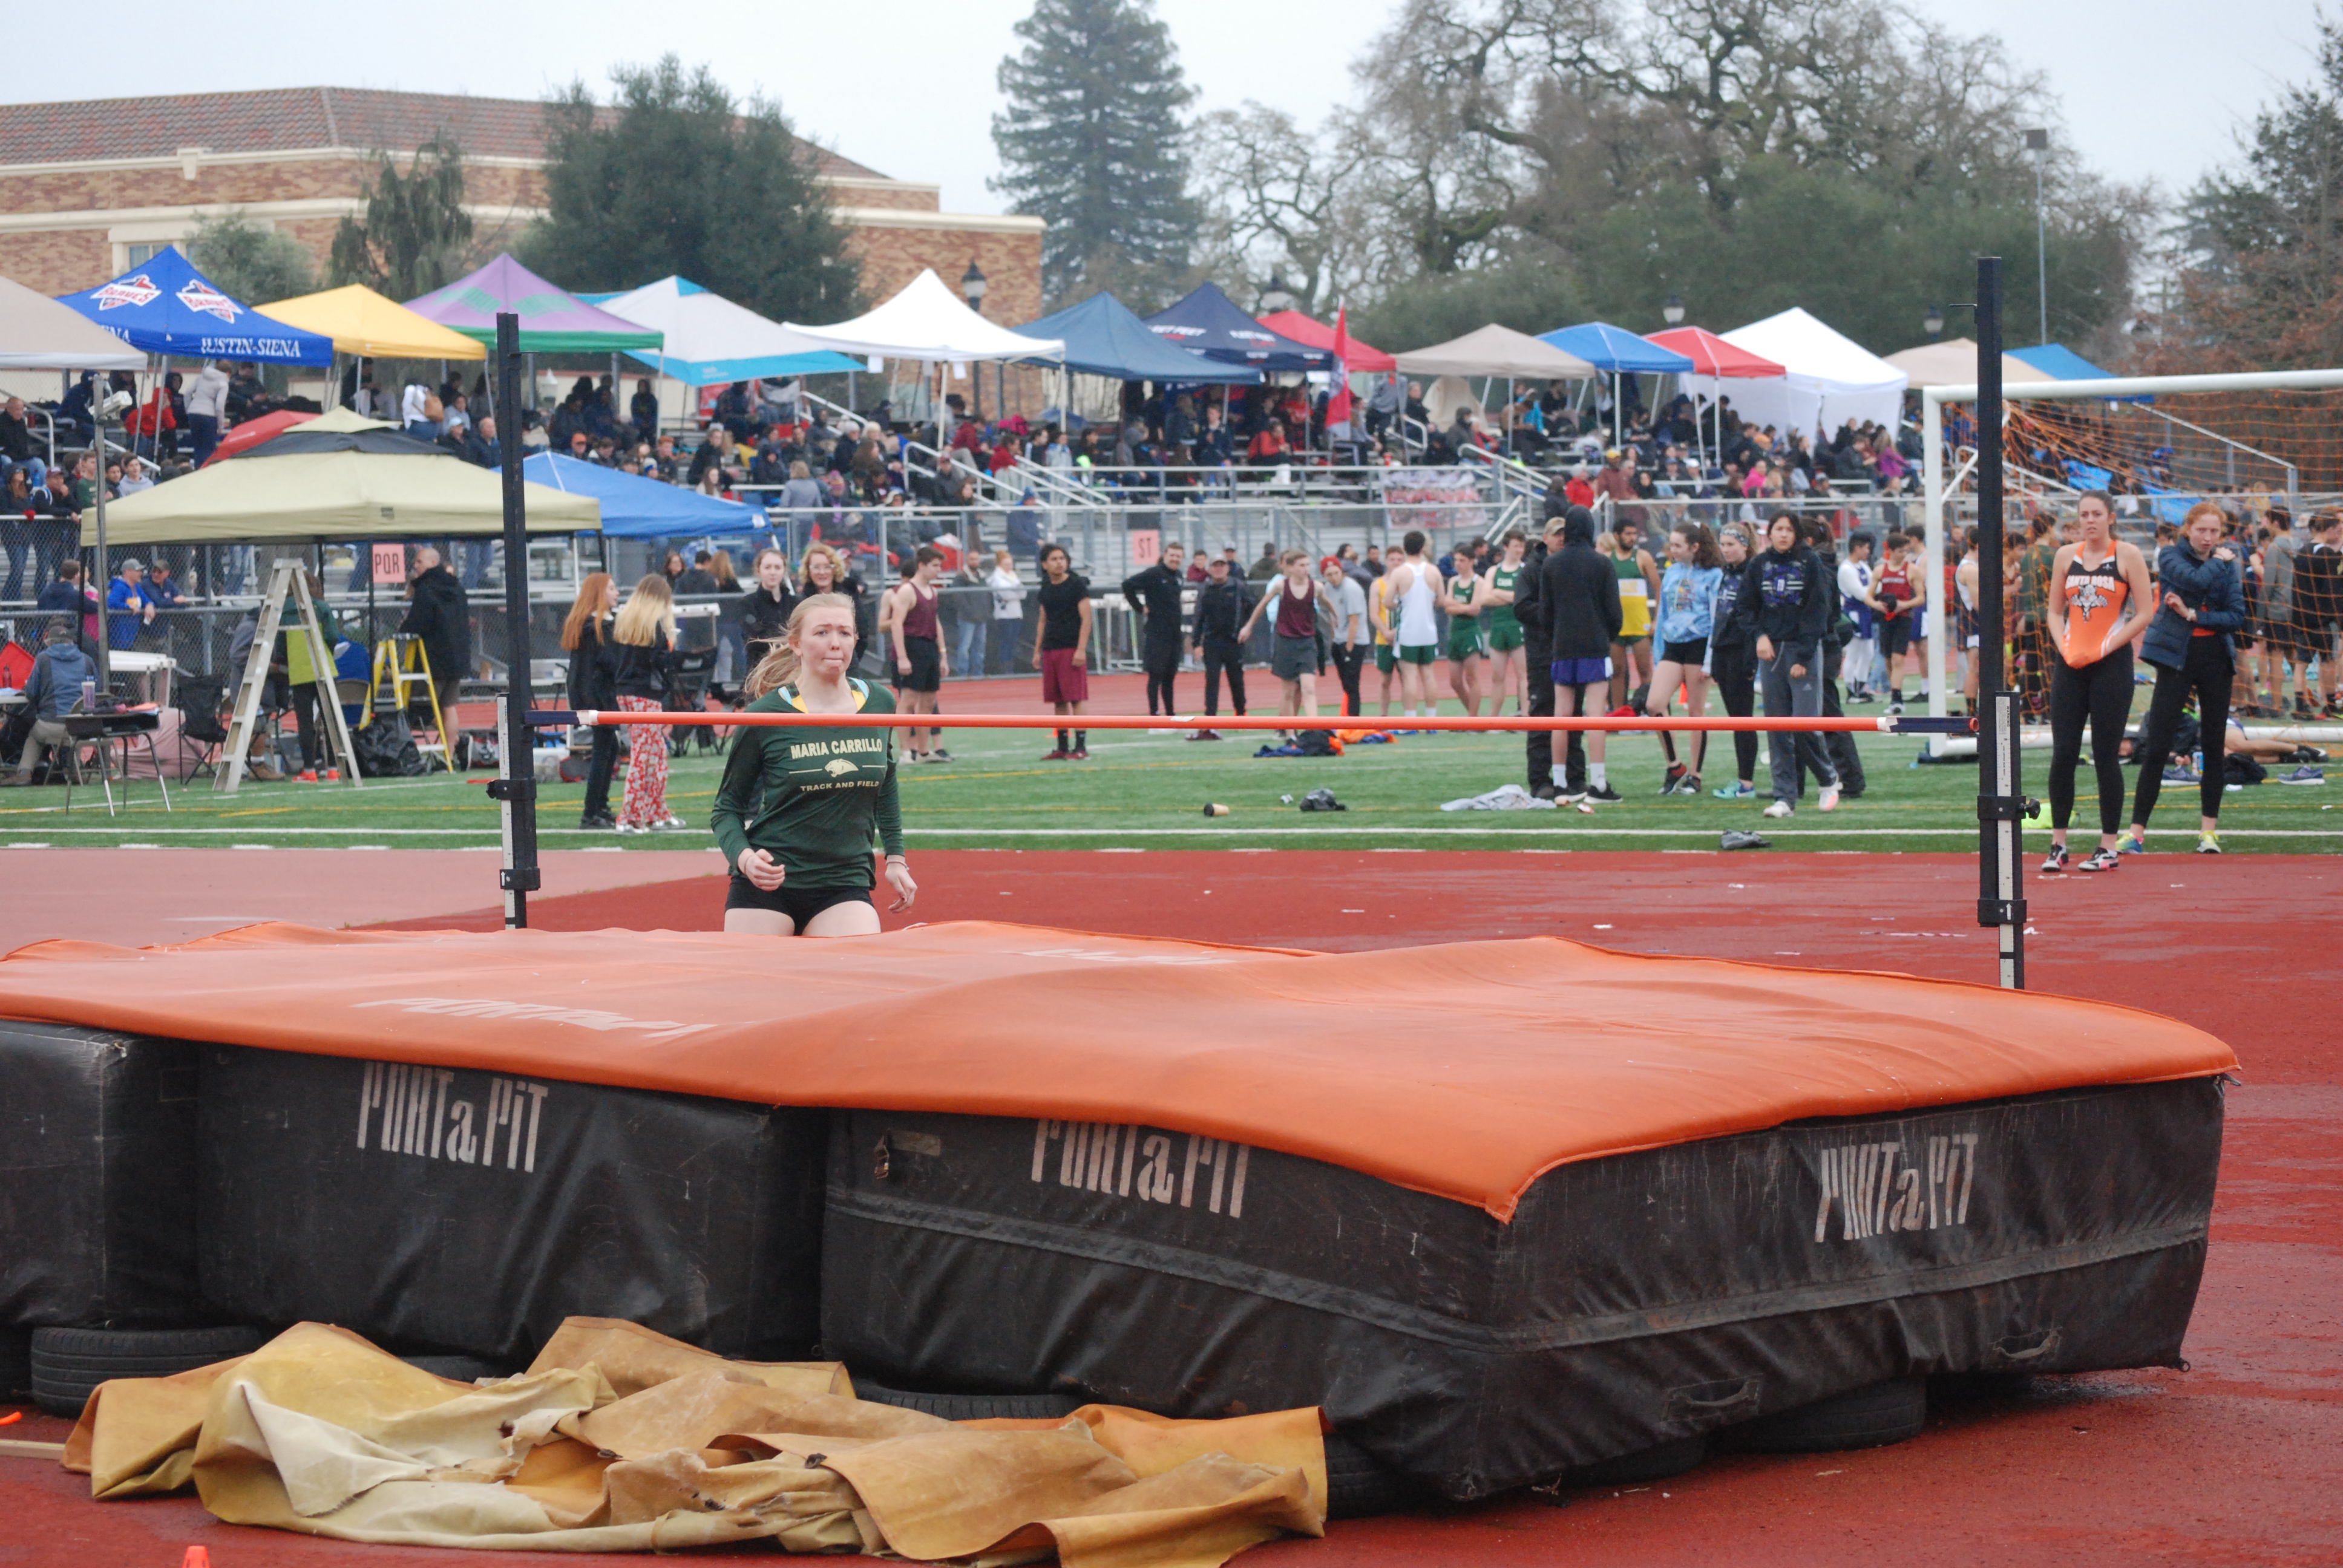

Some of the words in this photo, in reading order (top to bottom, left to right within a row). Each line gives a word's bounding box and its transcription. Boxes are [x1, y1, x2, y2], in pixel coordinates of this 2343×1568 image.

[201, 338, 301, 358] JUSTIN-SIENA
[375, 553, 399, 574] PQR
[2091, 575, 2116, 592] ROSA
[790, 742, 830, 759] MARIA
[831, 738, 883, 754] CARRILLO
[800, 783, 832, 792] TRACK
